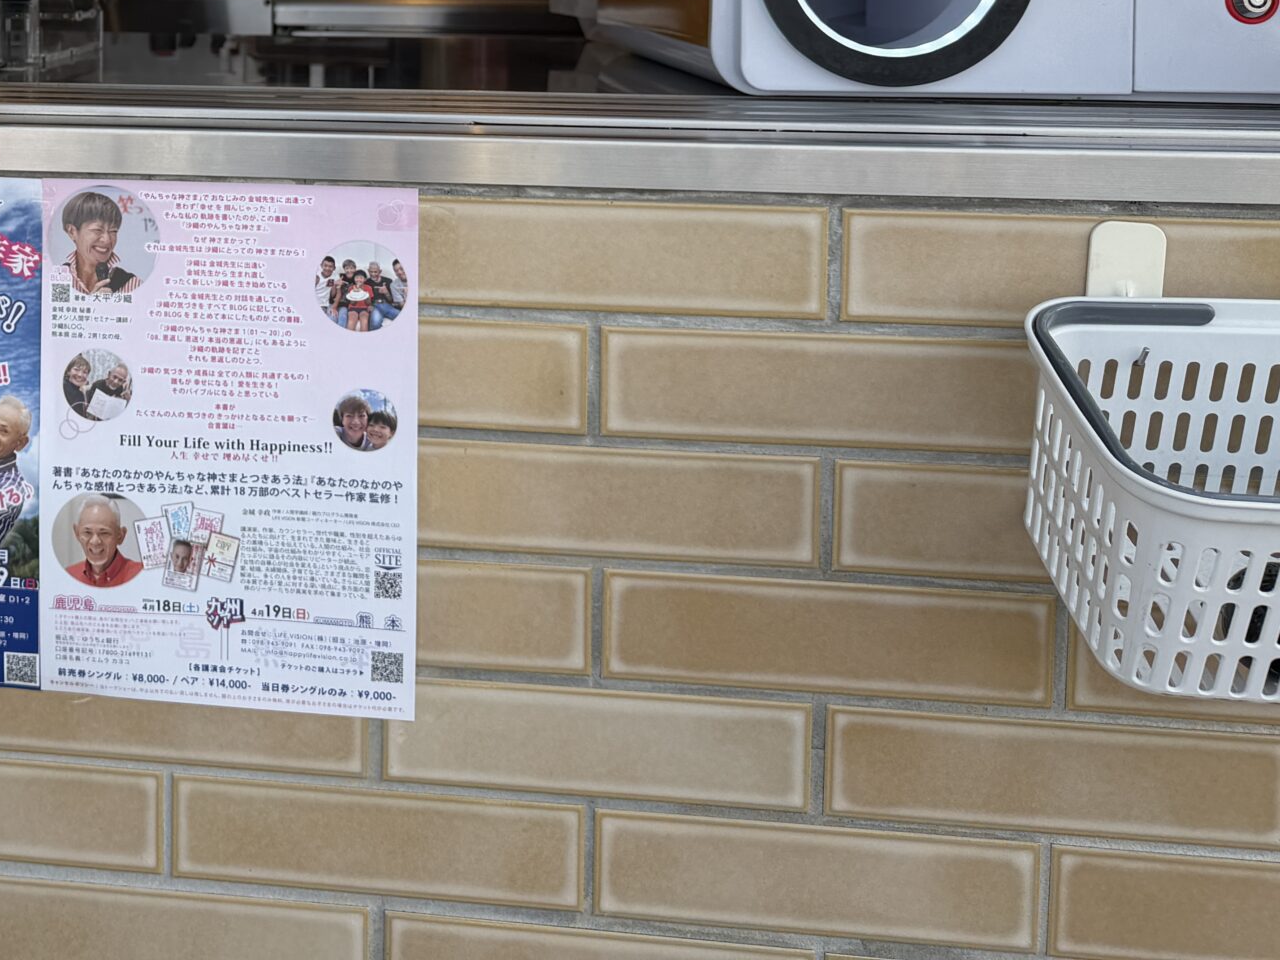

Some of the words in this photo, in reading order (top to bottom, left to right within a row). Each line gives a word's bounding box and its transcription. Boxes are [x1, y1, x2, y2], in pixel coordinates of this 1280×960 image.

[120, 434, 142, 448] Fill
[146, 435, 179, 448] Your
[184, 437, 210, 450] Life
[214, 439, 245, 451] with
[250, 440, 333, 455] Happiness!!
[374, 554, 402, 566] SITE
[54, 596, 95, 611] 鹿児島
